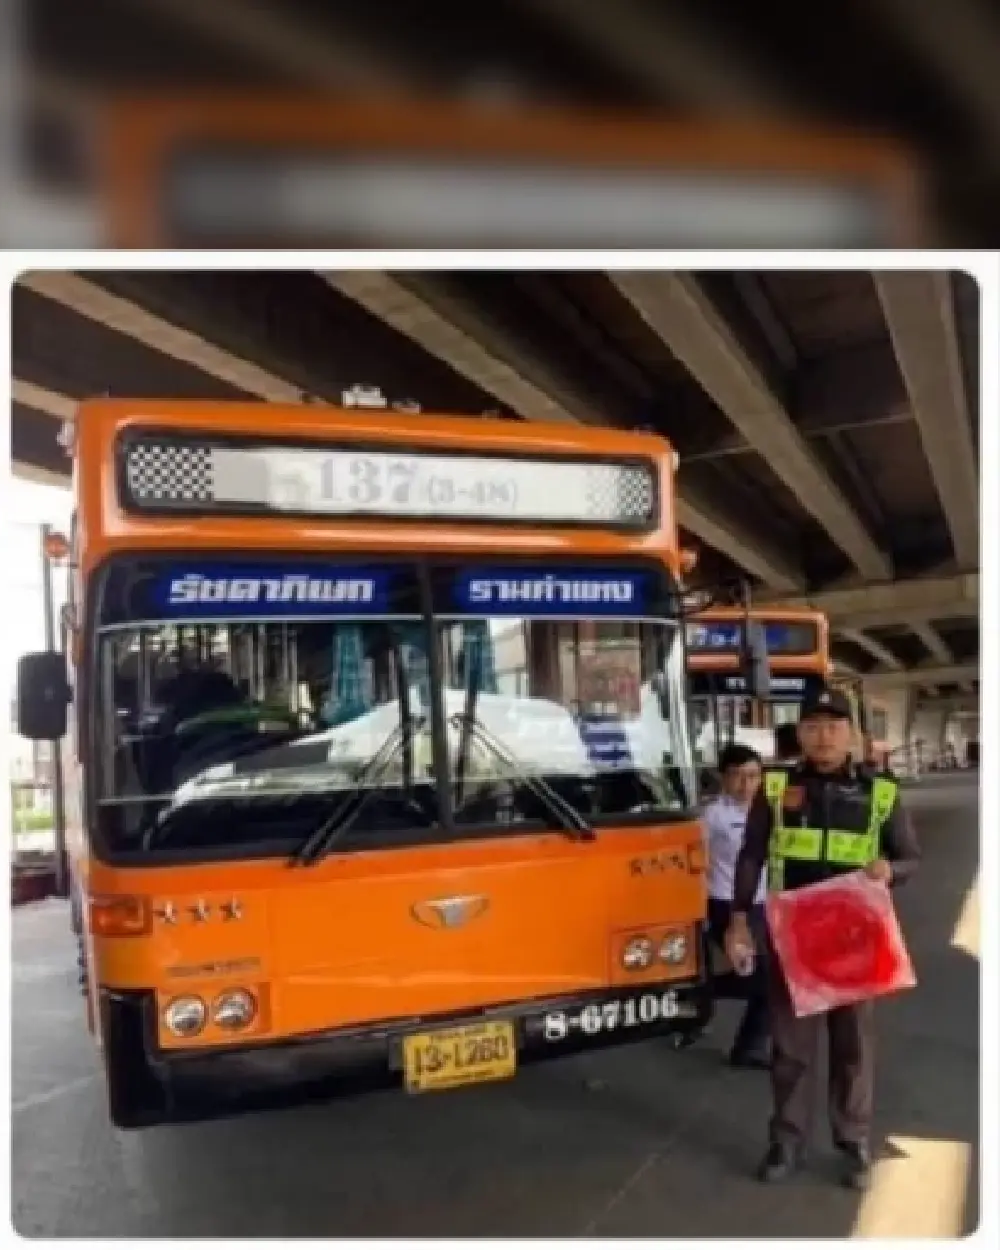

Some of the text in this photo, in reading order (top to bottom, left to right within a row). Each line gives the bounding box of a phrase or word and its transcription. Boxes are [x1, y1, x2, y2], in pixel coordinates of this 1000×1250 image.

[320, 458, 417, 503] 137
[469, 574, 633, 603] รามคำแหง
[545, 990, 679, 1042] 8-67106
